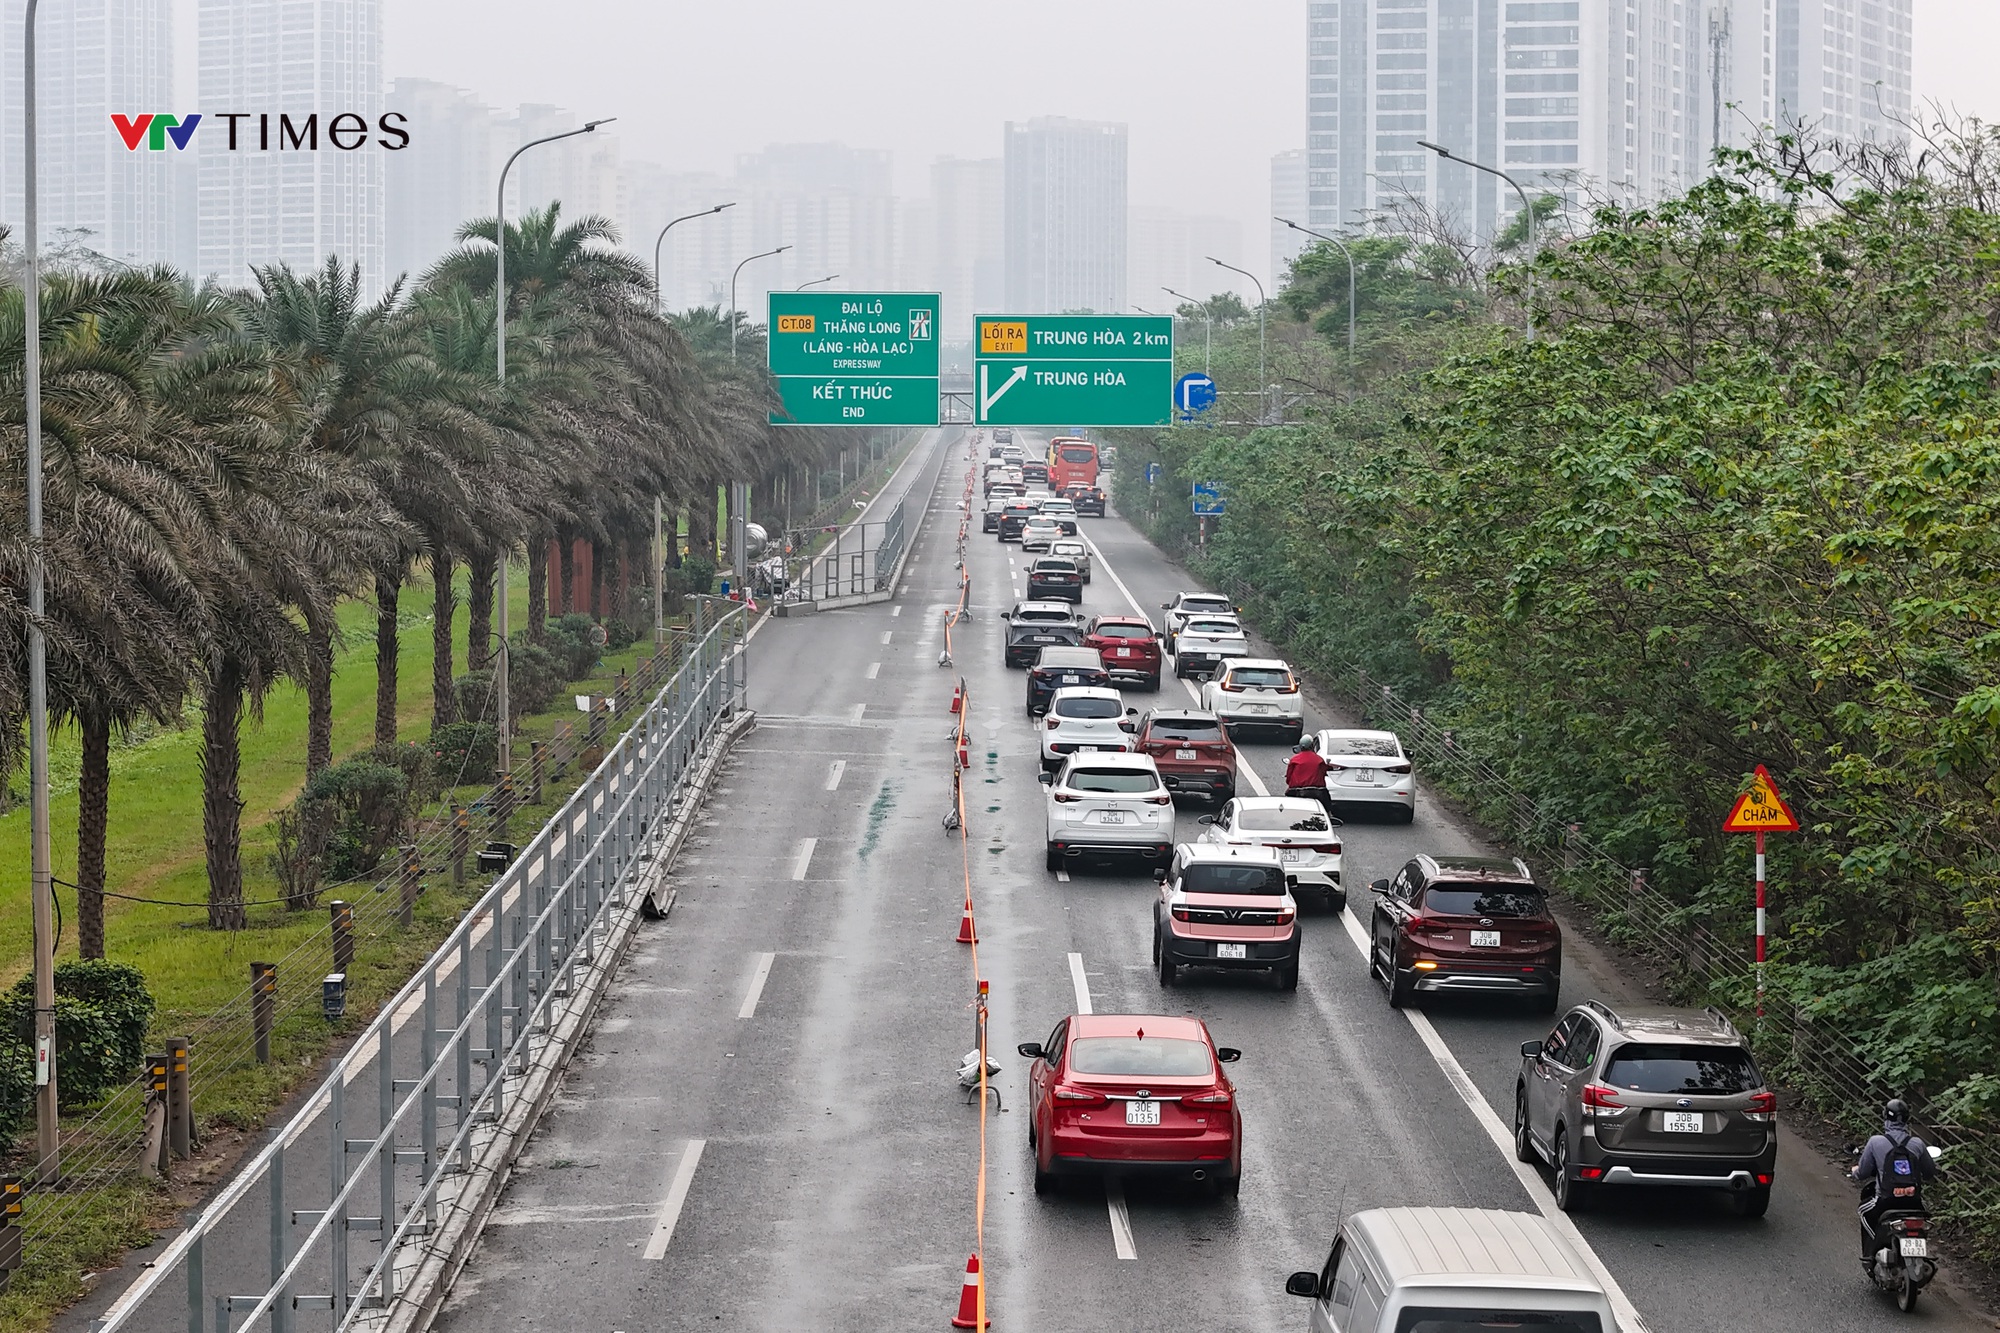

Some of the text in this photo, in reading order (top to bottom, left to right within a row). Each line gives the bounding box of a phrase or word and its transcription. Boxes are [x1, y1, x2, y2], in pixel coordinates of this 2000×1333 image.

[842, 299, 883, 317] ĐẠI LỘ
[781, 318, 812, 330] CT.08
[823, 319, 901, 334] THĂNG LONG
[984, 322, 1024, 340] LỐI RA
[1034, 328, 1169, 345] TRUNG HÒA 2 km
[853, 338, 879, 354] HÒA
[995, 342, 1013, 351] EXIT
[833, 359, 882, 369] EXPRESSWAY
[1034, 369, 1127, 386] TRUNG HÒA
[813, 379, 893, 400] KẾT THÚC
[843, 407, 865, 418] END
[1743, 806, 1778, 824] CHẬM
[1134, 1102, 1153, 1113] 30E
[1127, 1113, 1159, 1124] 013.51
[1675, 1113, 1692, 1122] 30B
[1669, 1122, 1699, 1132] 155.50
